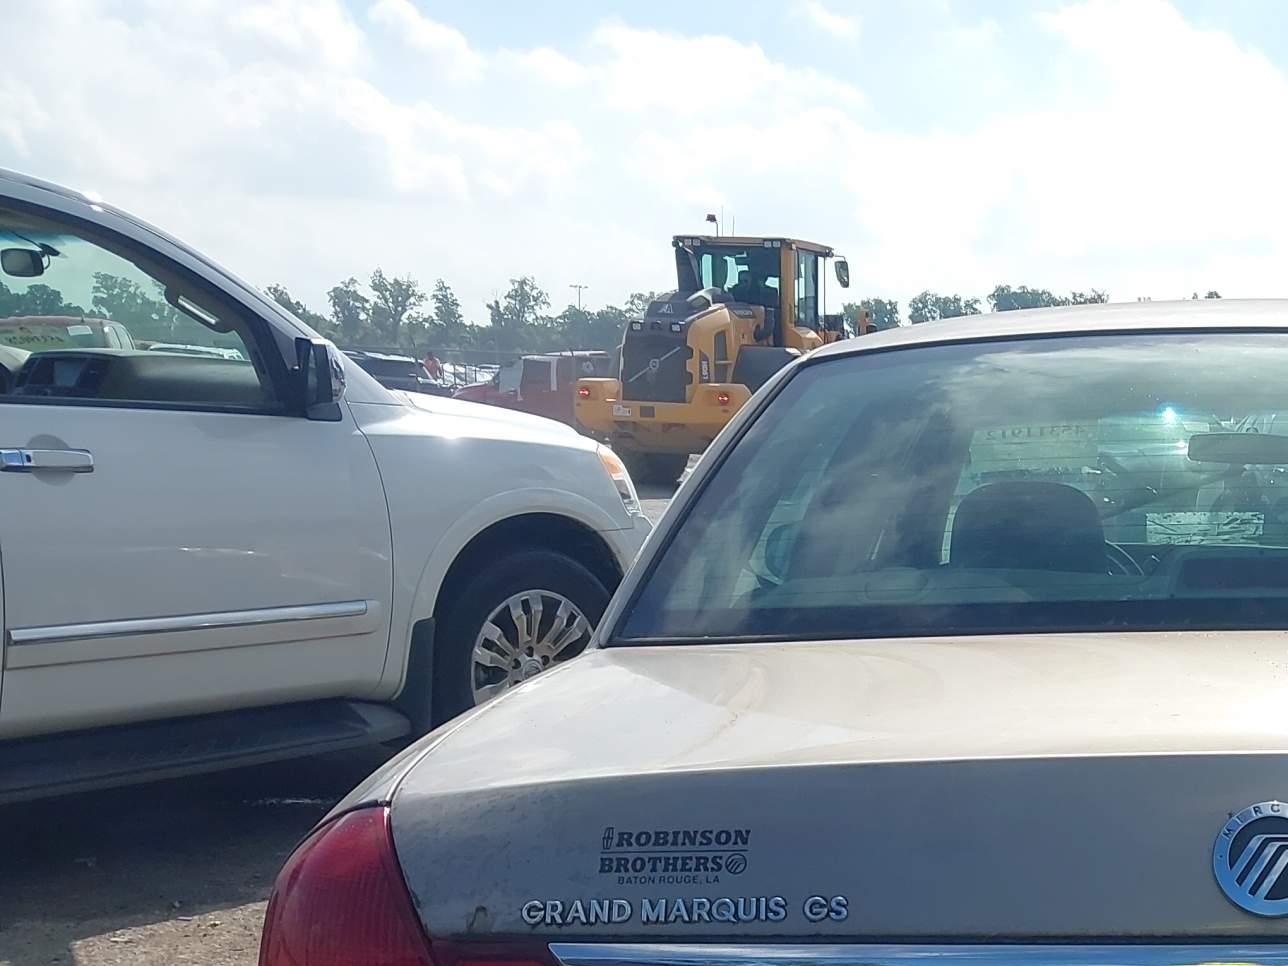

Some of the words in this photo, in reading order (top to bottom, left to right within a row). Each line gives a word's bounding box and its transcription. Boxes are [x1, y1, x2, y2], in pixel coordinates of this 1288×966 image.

[615, 829, 751, 848] ROBINSON
[599, 856, 723, 874] BROTHERS
[617, 876, 655, 885] BATON
[703, 875, 720, 884] LA
[521, 899, 632, 925] GRAND
[641, 896, 788, 925] MARQUIS
[803, 896, 849, 922] GS
